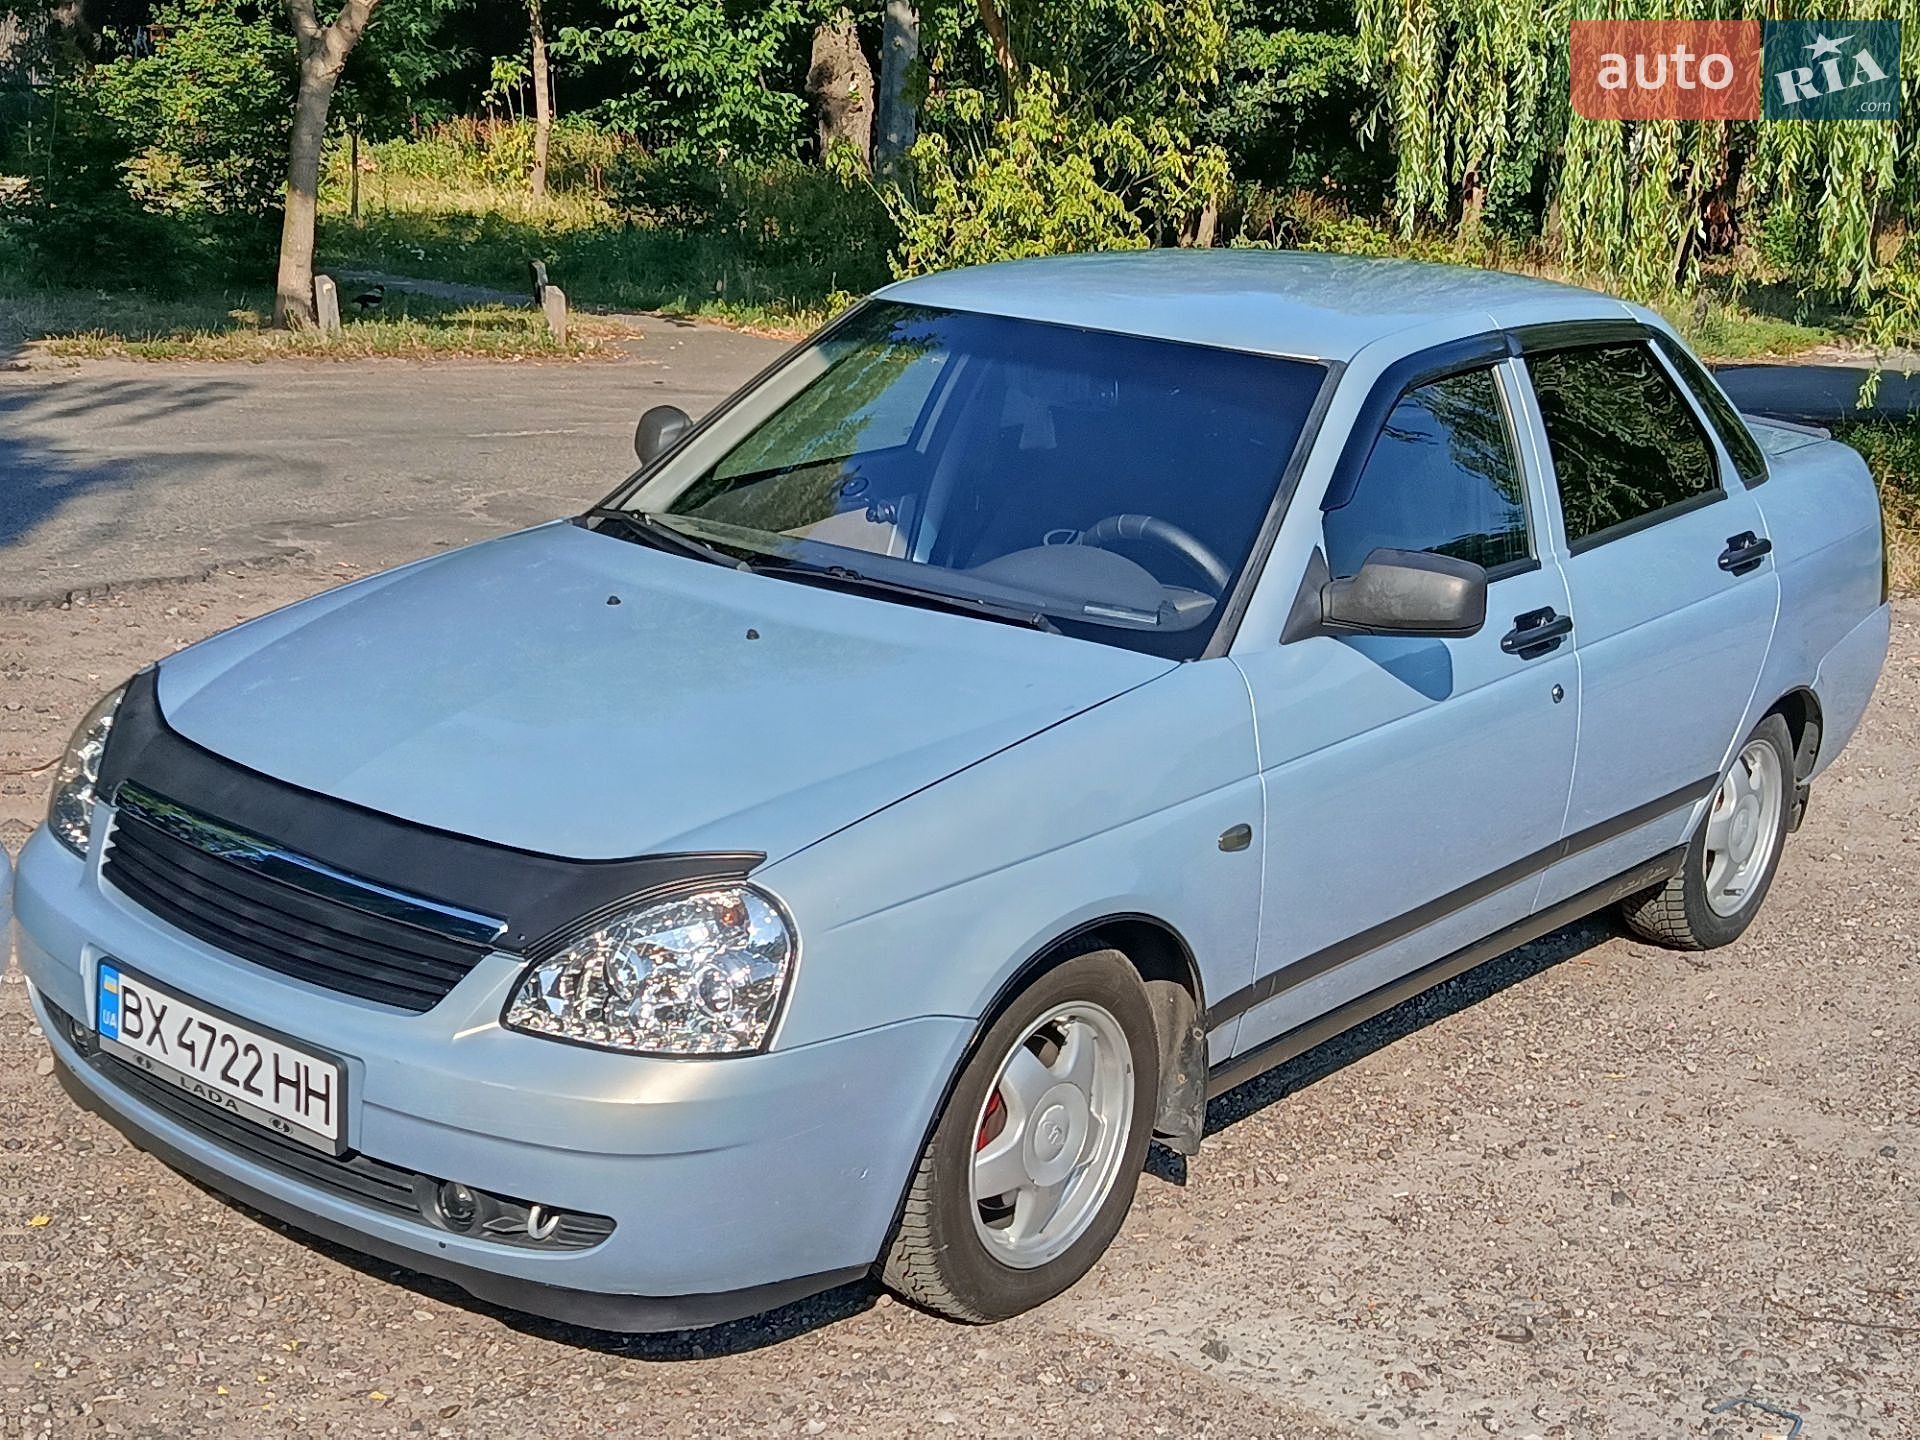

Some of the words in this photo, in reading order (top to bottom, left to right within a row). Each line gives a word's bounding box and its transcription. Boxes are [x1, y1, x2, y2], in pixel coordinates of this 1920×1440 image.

[102, 1009, 118, 1028] UA
[121, 984, 168, 1055] BX
[177, 1017, 263, 1097] 4722
[273, 1053, 330, 1126] HH
[180, 1076, 239, 1112] LADA
